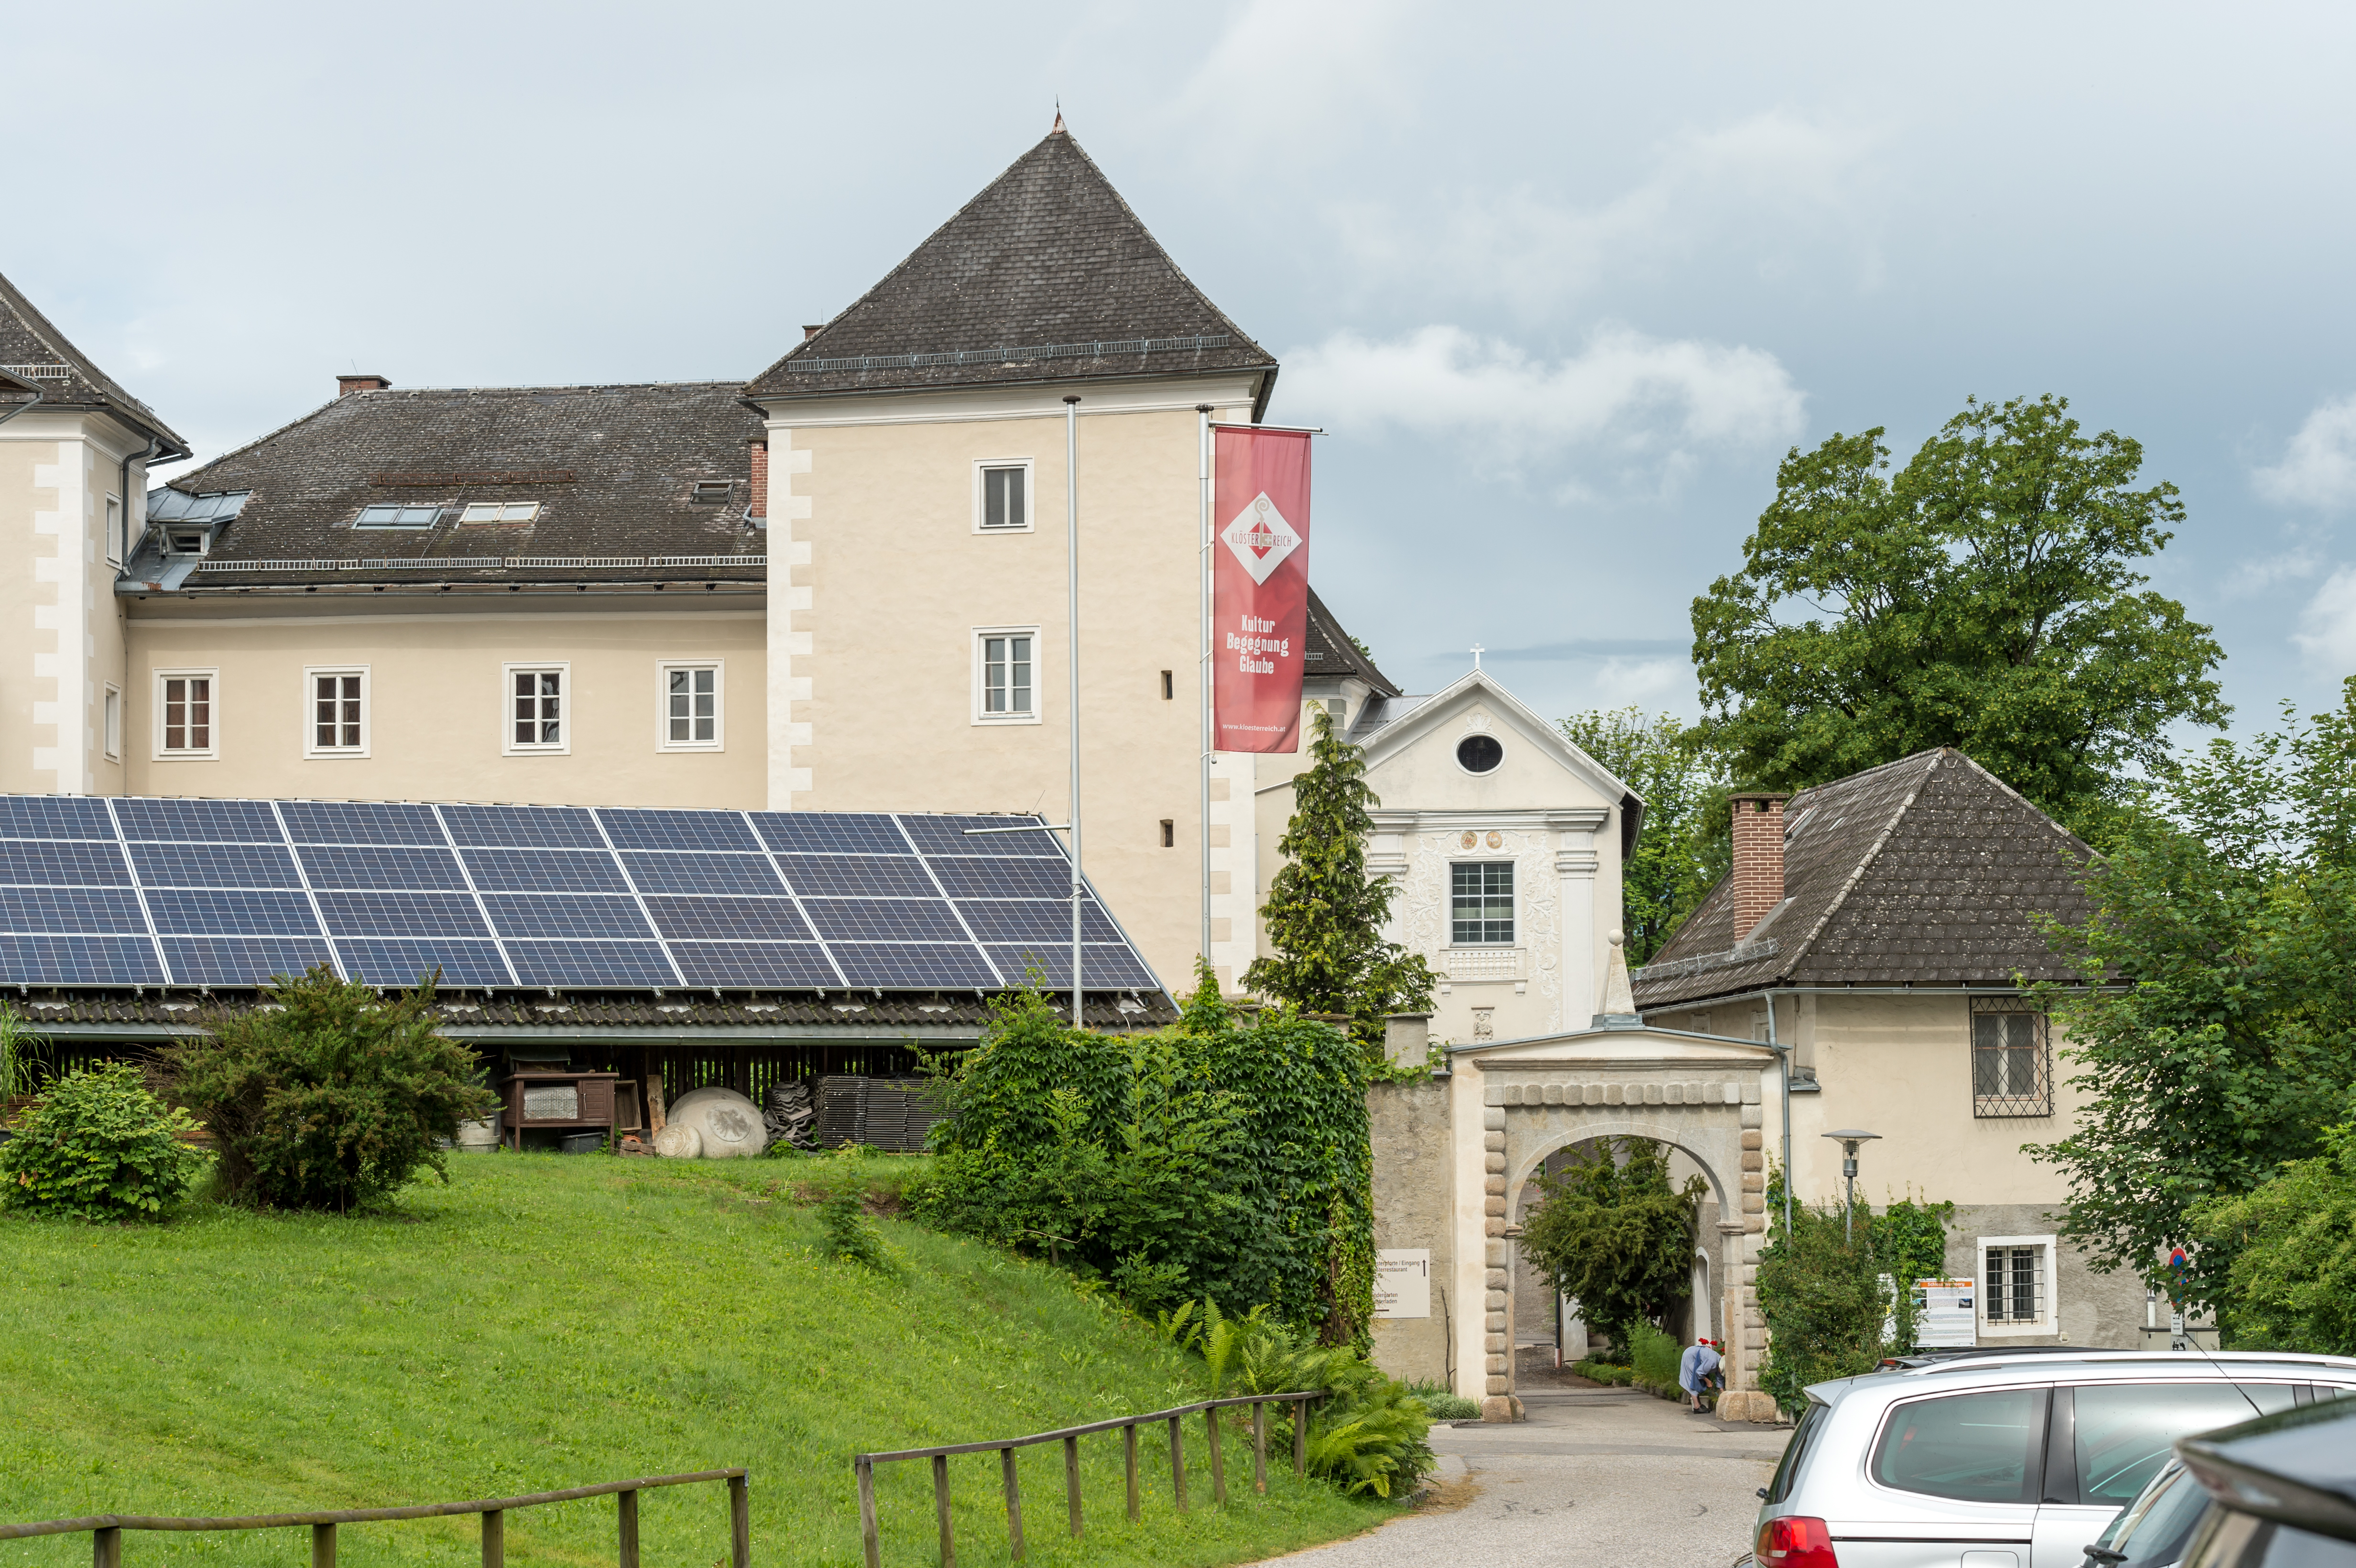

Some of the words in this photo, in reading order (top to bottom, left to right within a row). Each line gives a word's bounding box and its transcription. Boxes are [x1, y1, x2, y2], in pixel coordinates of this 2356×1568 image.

[1242, 615, 1276, 633] Kultur
[1227, 632, 1289, 657] Begegnung
[1240, 655, 1274, 674] Glaube
[1222, 724, 1286, 732] www.kloesterreich.at
